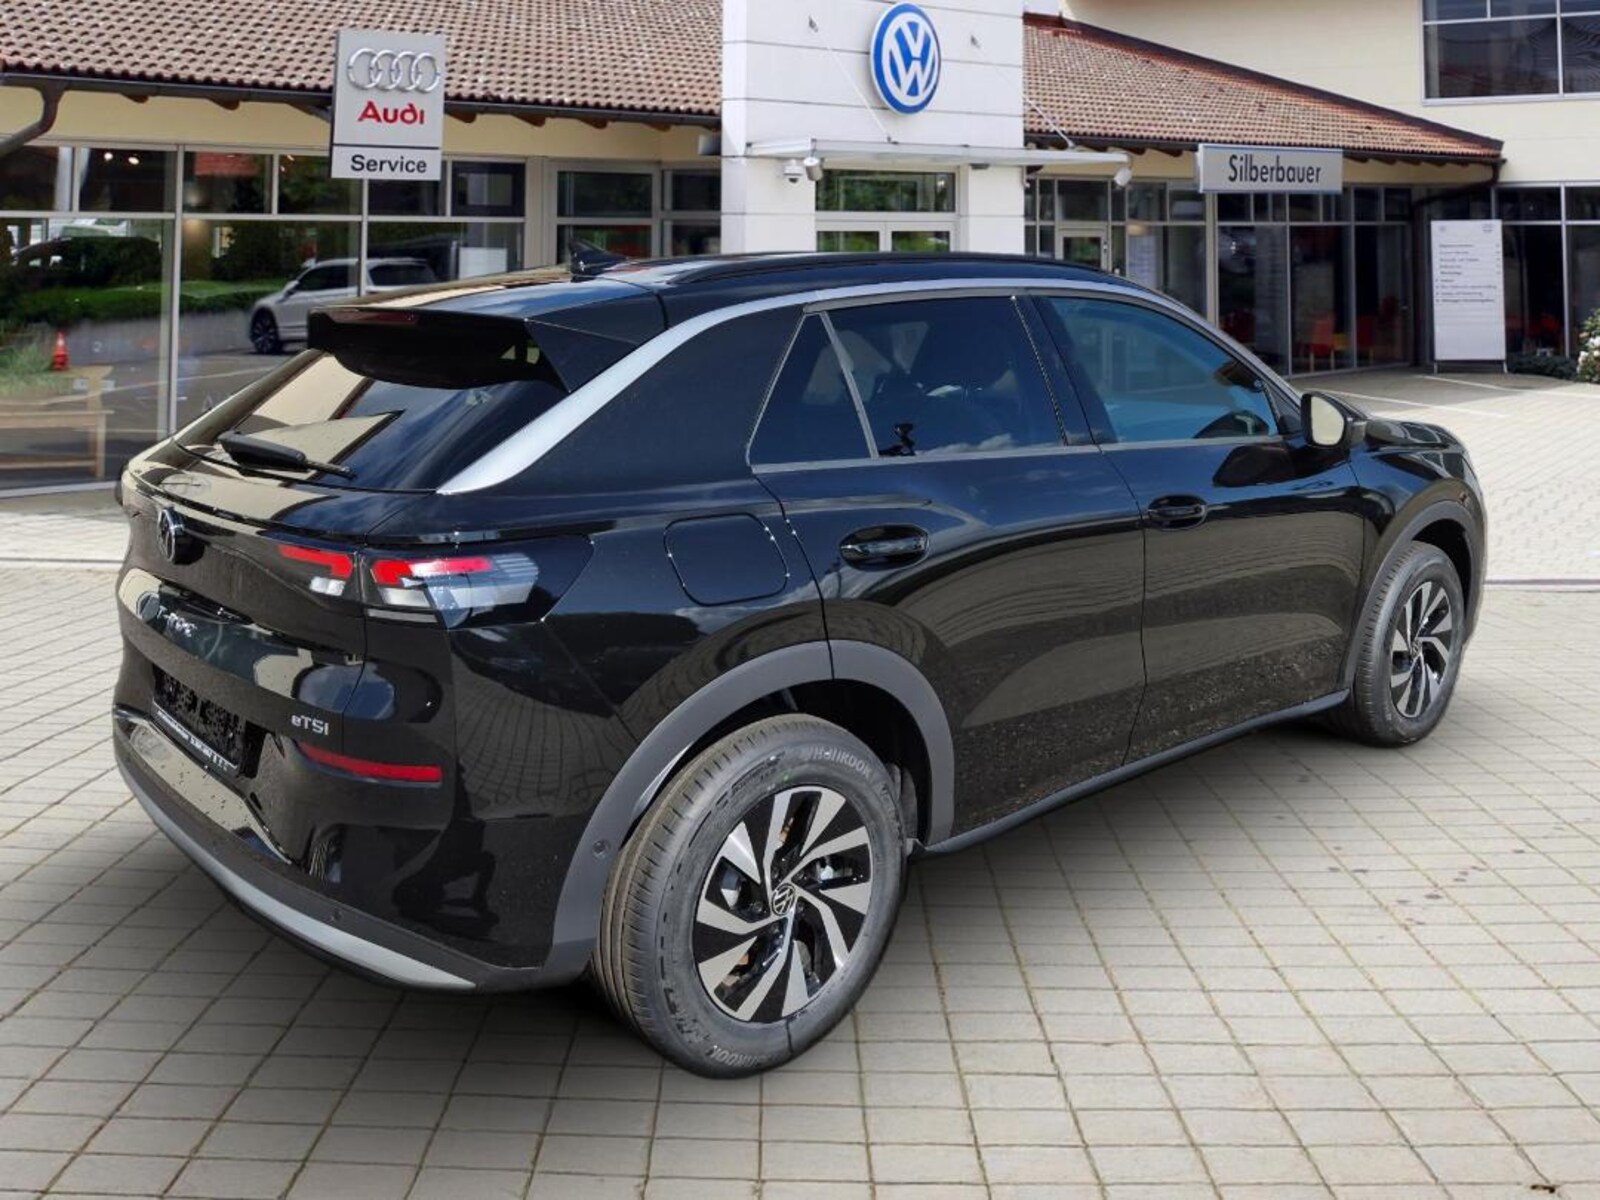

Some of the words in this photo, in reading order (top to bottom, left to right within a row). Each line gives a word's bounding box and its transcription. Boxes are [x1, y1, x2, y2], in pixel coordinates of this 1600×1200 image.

[357, 100, 425, 125] Audi
[350, 154, 427, 173] Service
[1228, 154, 1321, 183] Silberbauer
[291, 714, 329, 736] eTSI
